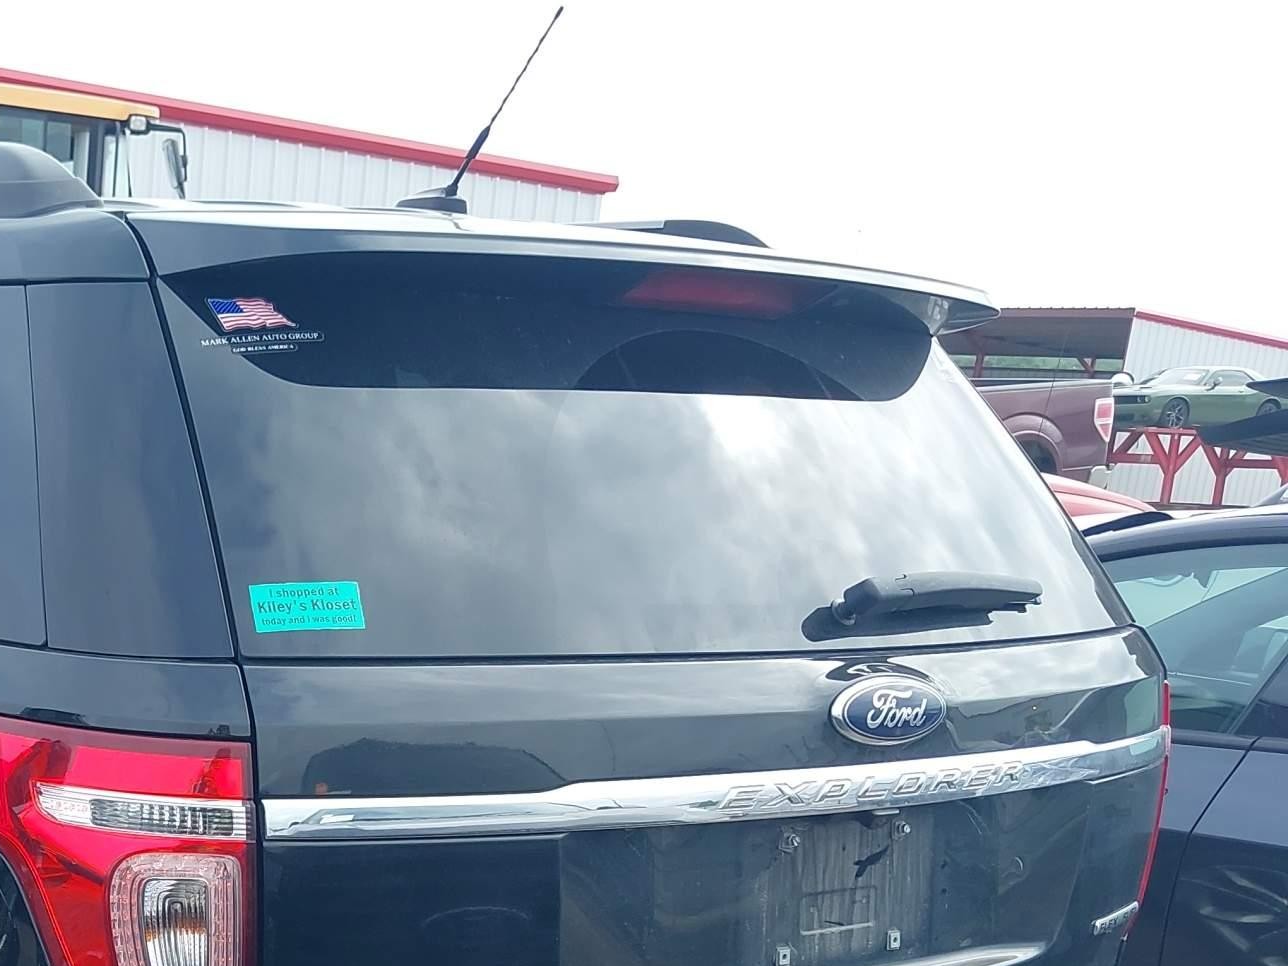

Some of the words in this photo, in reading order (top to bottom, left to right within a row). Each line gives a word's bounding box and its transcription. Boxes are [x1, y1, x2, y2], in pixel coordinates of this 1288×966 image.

[200, 337, 228, 346] MARK
[230, 335, 260, 344] ALLEN
[262, 333, 287, 342] AUTO
[288, 332, 319, 340] GROUP
[275, 586, 325, 599] shopped
[328, 586, 340, 597] at
[256, 599, 308, 614] Kiley's
[310, 598, 358, 611] Kloset
[261, 616, 287, 626] today
[866, 688, 927, 729] Ford
[718, 760, 1024, 810] EXPLORER
